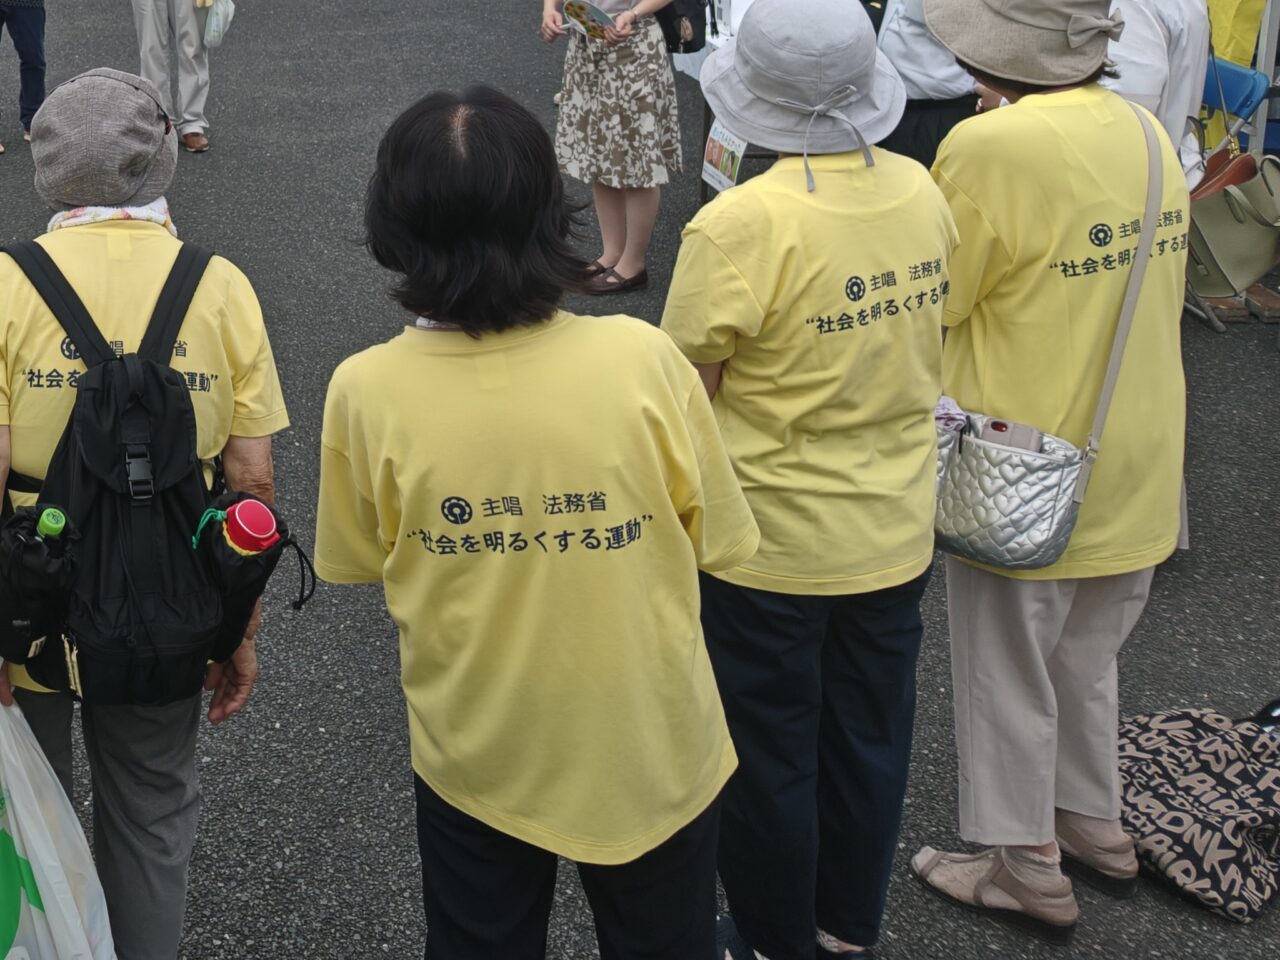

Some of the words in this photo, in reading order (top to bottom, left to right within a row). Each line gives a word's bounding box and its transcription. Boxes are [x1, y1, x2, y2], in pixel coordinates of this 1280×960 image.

[1118, 218, 1141, 239] 主唱
[869, 270, 897, 292] 主唱
[481, 496, 524, 518] 主唱
[542, 491, 607, 515] 法務省
